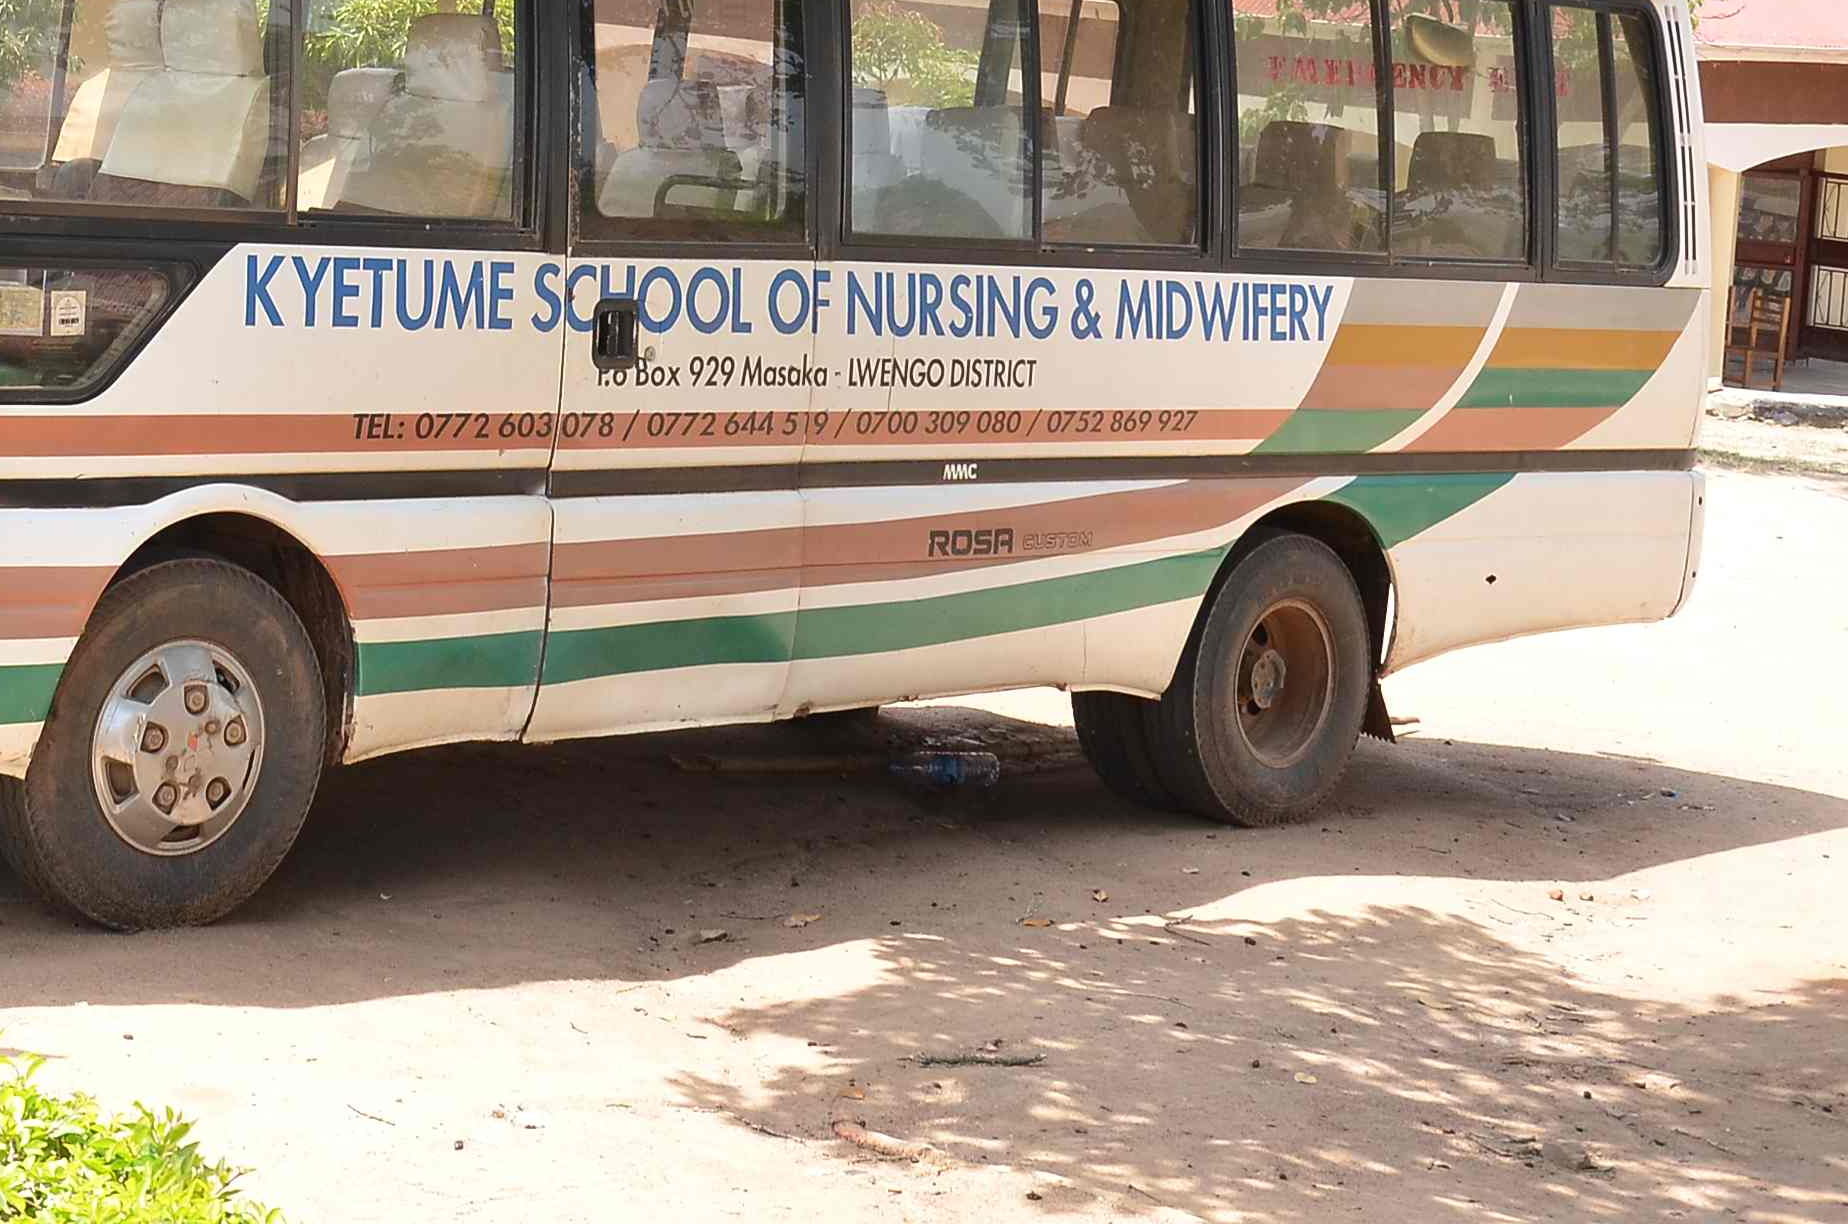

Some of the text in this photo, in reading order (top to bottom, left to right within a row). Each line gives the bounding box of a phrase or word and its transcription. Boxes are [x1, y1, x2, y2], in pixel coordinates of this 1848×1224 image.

[244, 254, 1334, 343] KYETUME SCHOOL OF NURSING & MIDWIFERY
[635, 356, 680, 387] Box
[689, 355, 735, 388] 929
[740, 353, 828, 387] Masaka
[848, 357, 944, 388] LWENGO
[949, 358, 1037, 388] DISTRICT
[352, 412, 405, 440] TEL:
[414, 412, 490, 440] 0772
[498, 412, 553, 439] 603
[561, 411, 615, 439] 078
[646, 411, 716, 439] 0772
[723, 410, 775, 437] 644
[855, 410, 919, 436] 0700
[925, 410, 971, 436] 309
[976, 410, 1023, 435] 080
[1046, 409, 1103, 435] 0752
[1109, 409, 1152, 434] 869
[1158, 409, 1199, 433] 927
[928, 528, 1094, 557] ROSA CUSTOM
